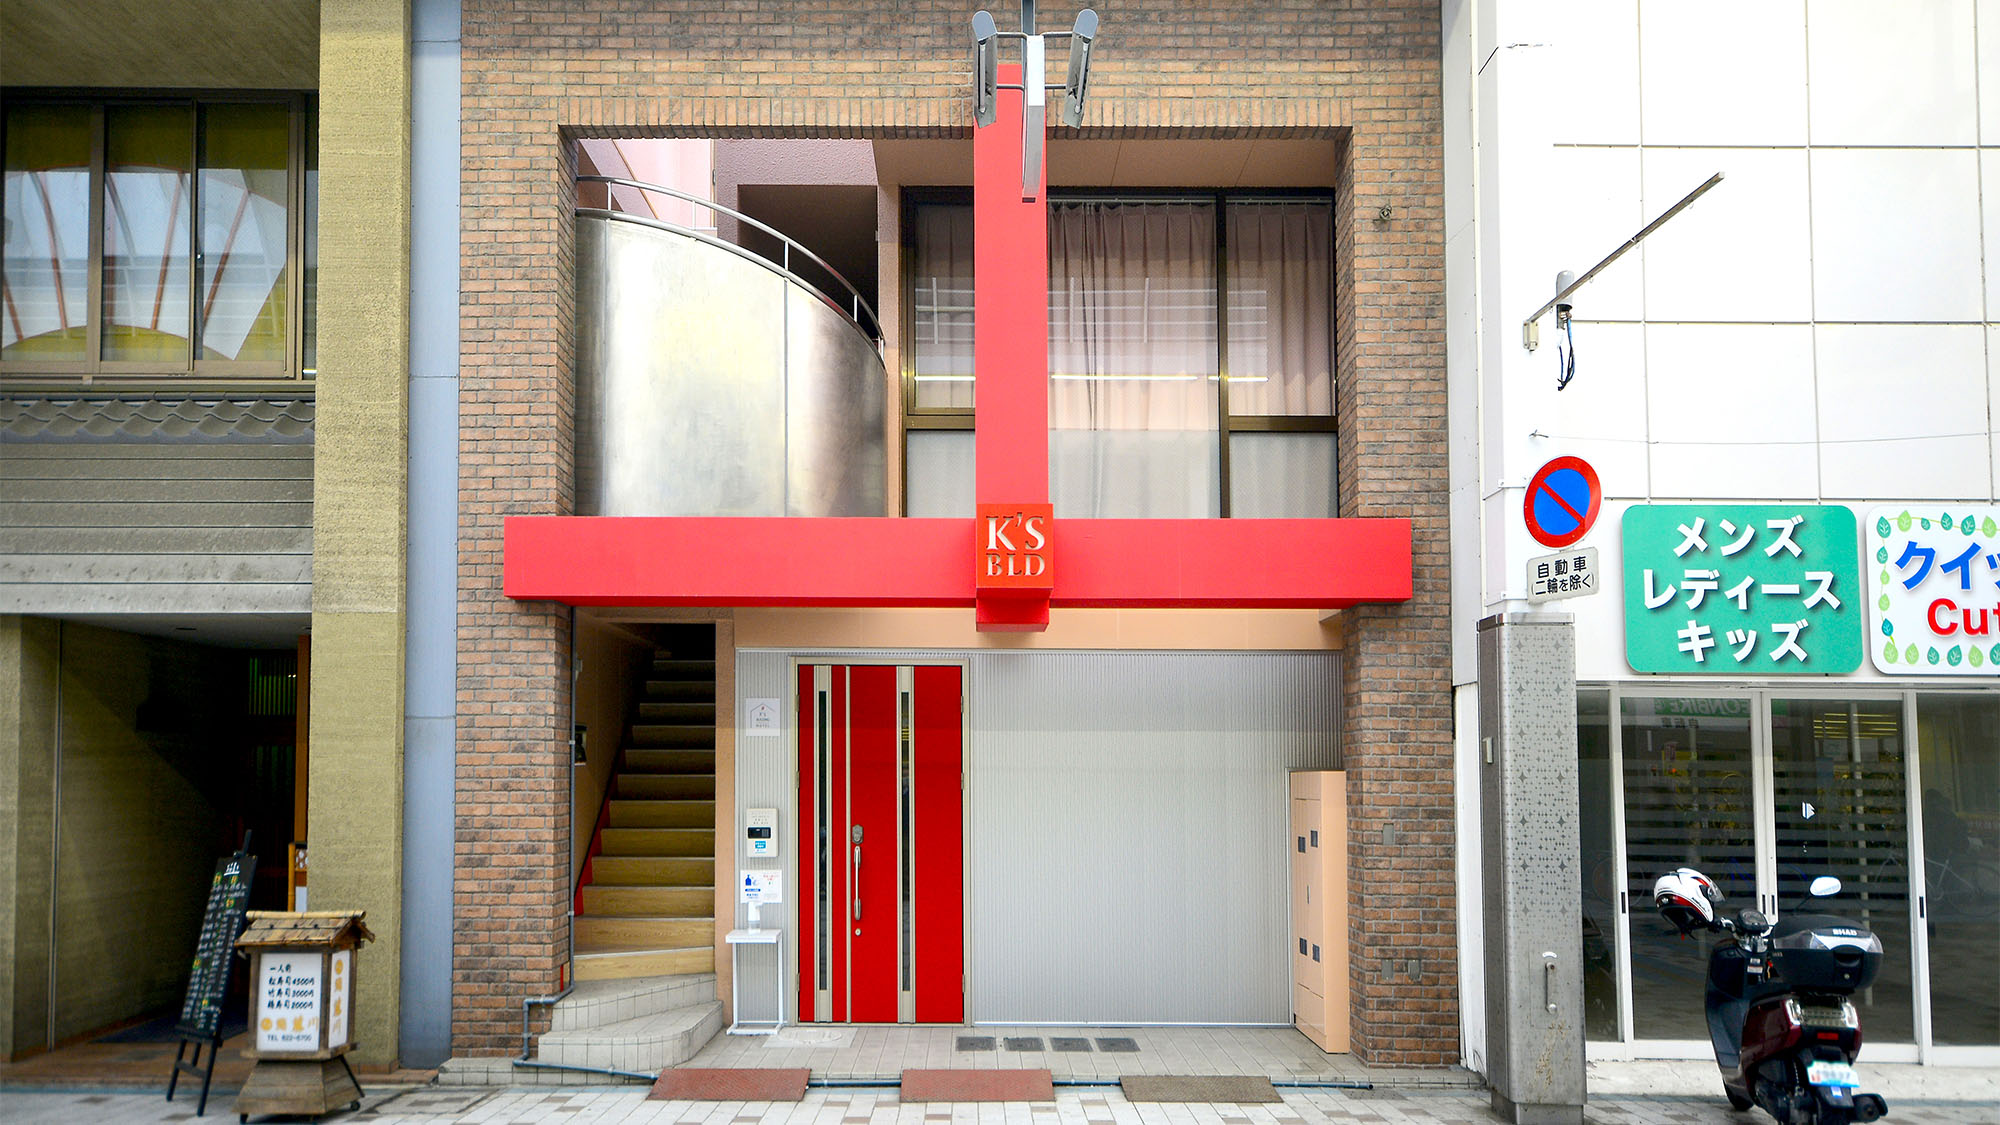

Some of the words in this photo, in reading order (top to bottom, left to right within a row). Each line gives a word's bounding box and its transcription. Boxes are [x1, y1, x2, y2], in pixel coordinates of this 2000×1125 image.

[986, 511, 1045, 551] K'S
[1673, 514, 1805, 559] メンズ
[986, 552, 1045, 577] BLD
[1537, 555, 1587, 579] 自動車
[1643, 568, 1841, 611] レディース
[1677, 618, 1809, 663] キッズ
